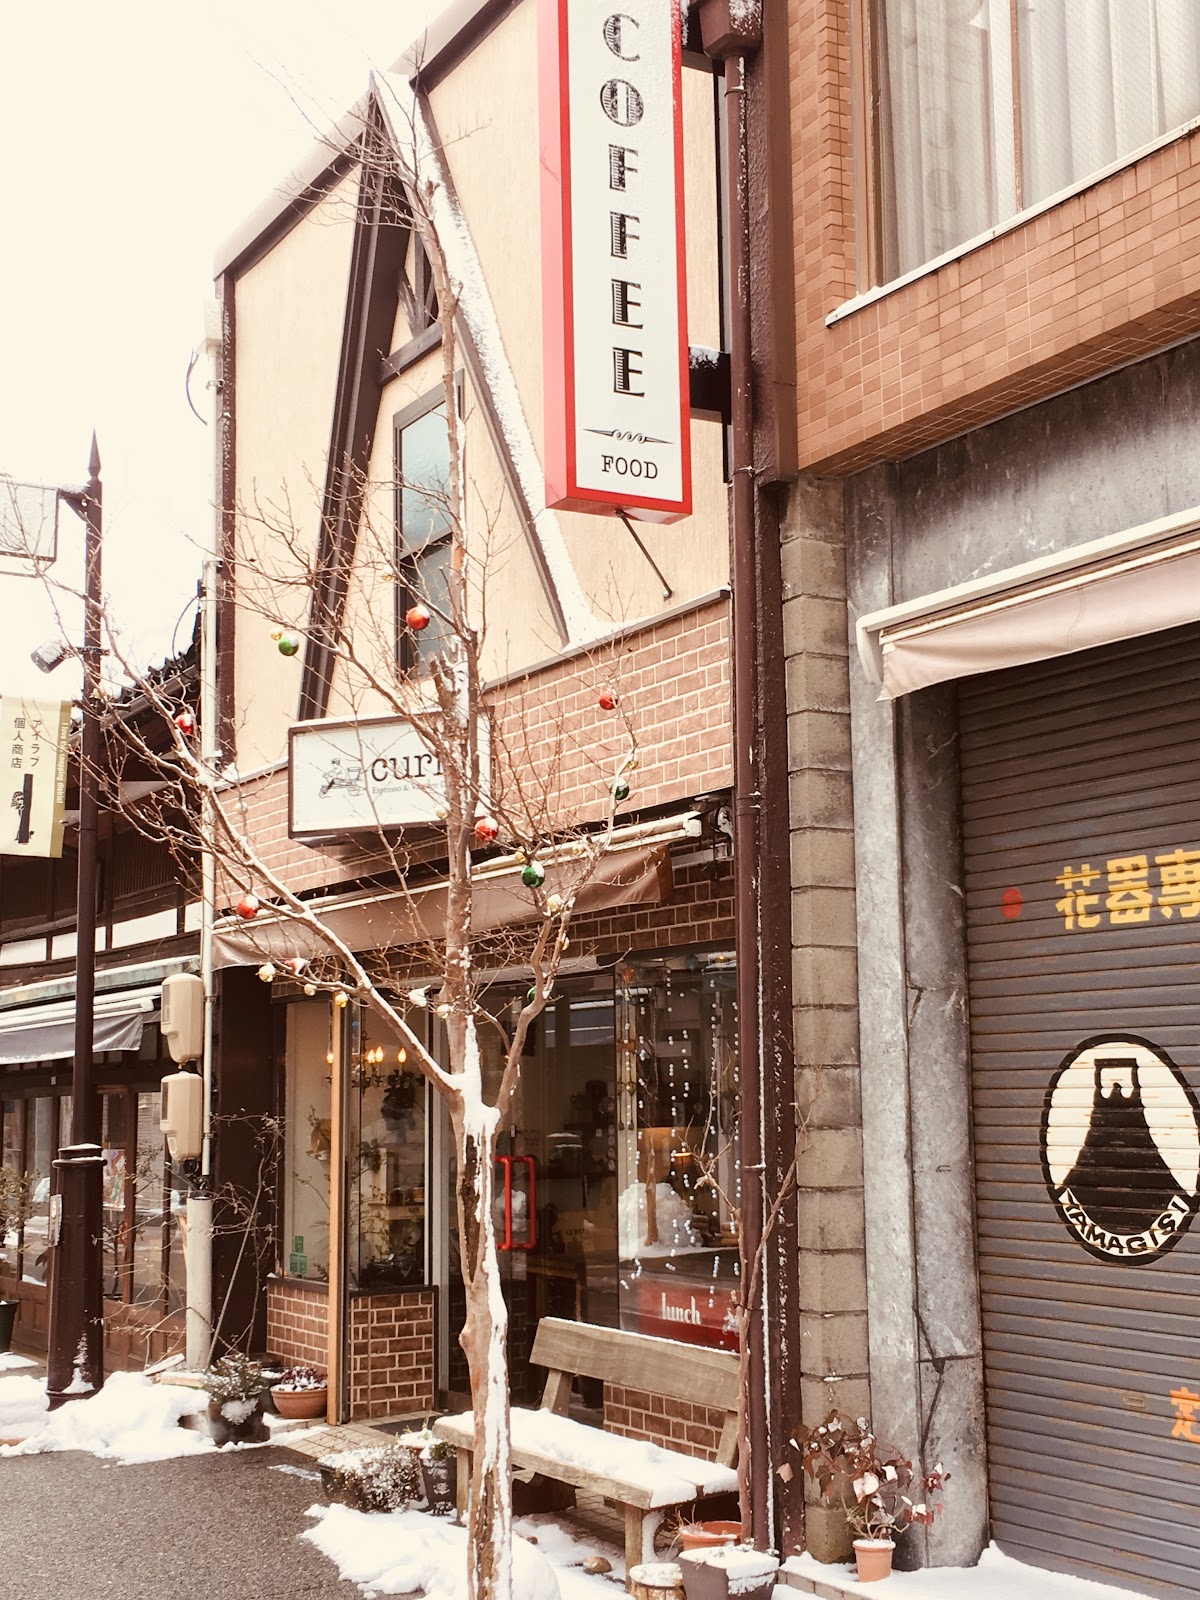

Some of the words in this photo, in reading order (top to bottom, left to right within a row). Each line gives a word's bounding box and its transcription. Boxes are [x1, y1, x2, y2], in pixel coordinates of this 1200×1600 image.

[599, 14, 645, 398] COFFEE
[601, 454, 658, 479] FOOD
[11, 717, 26, 769] 個人商店
[60, 727, 68, 739] love
[56, 782, 65, 804] district
[661, 1292, 701, 1325] lunch
